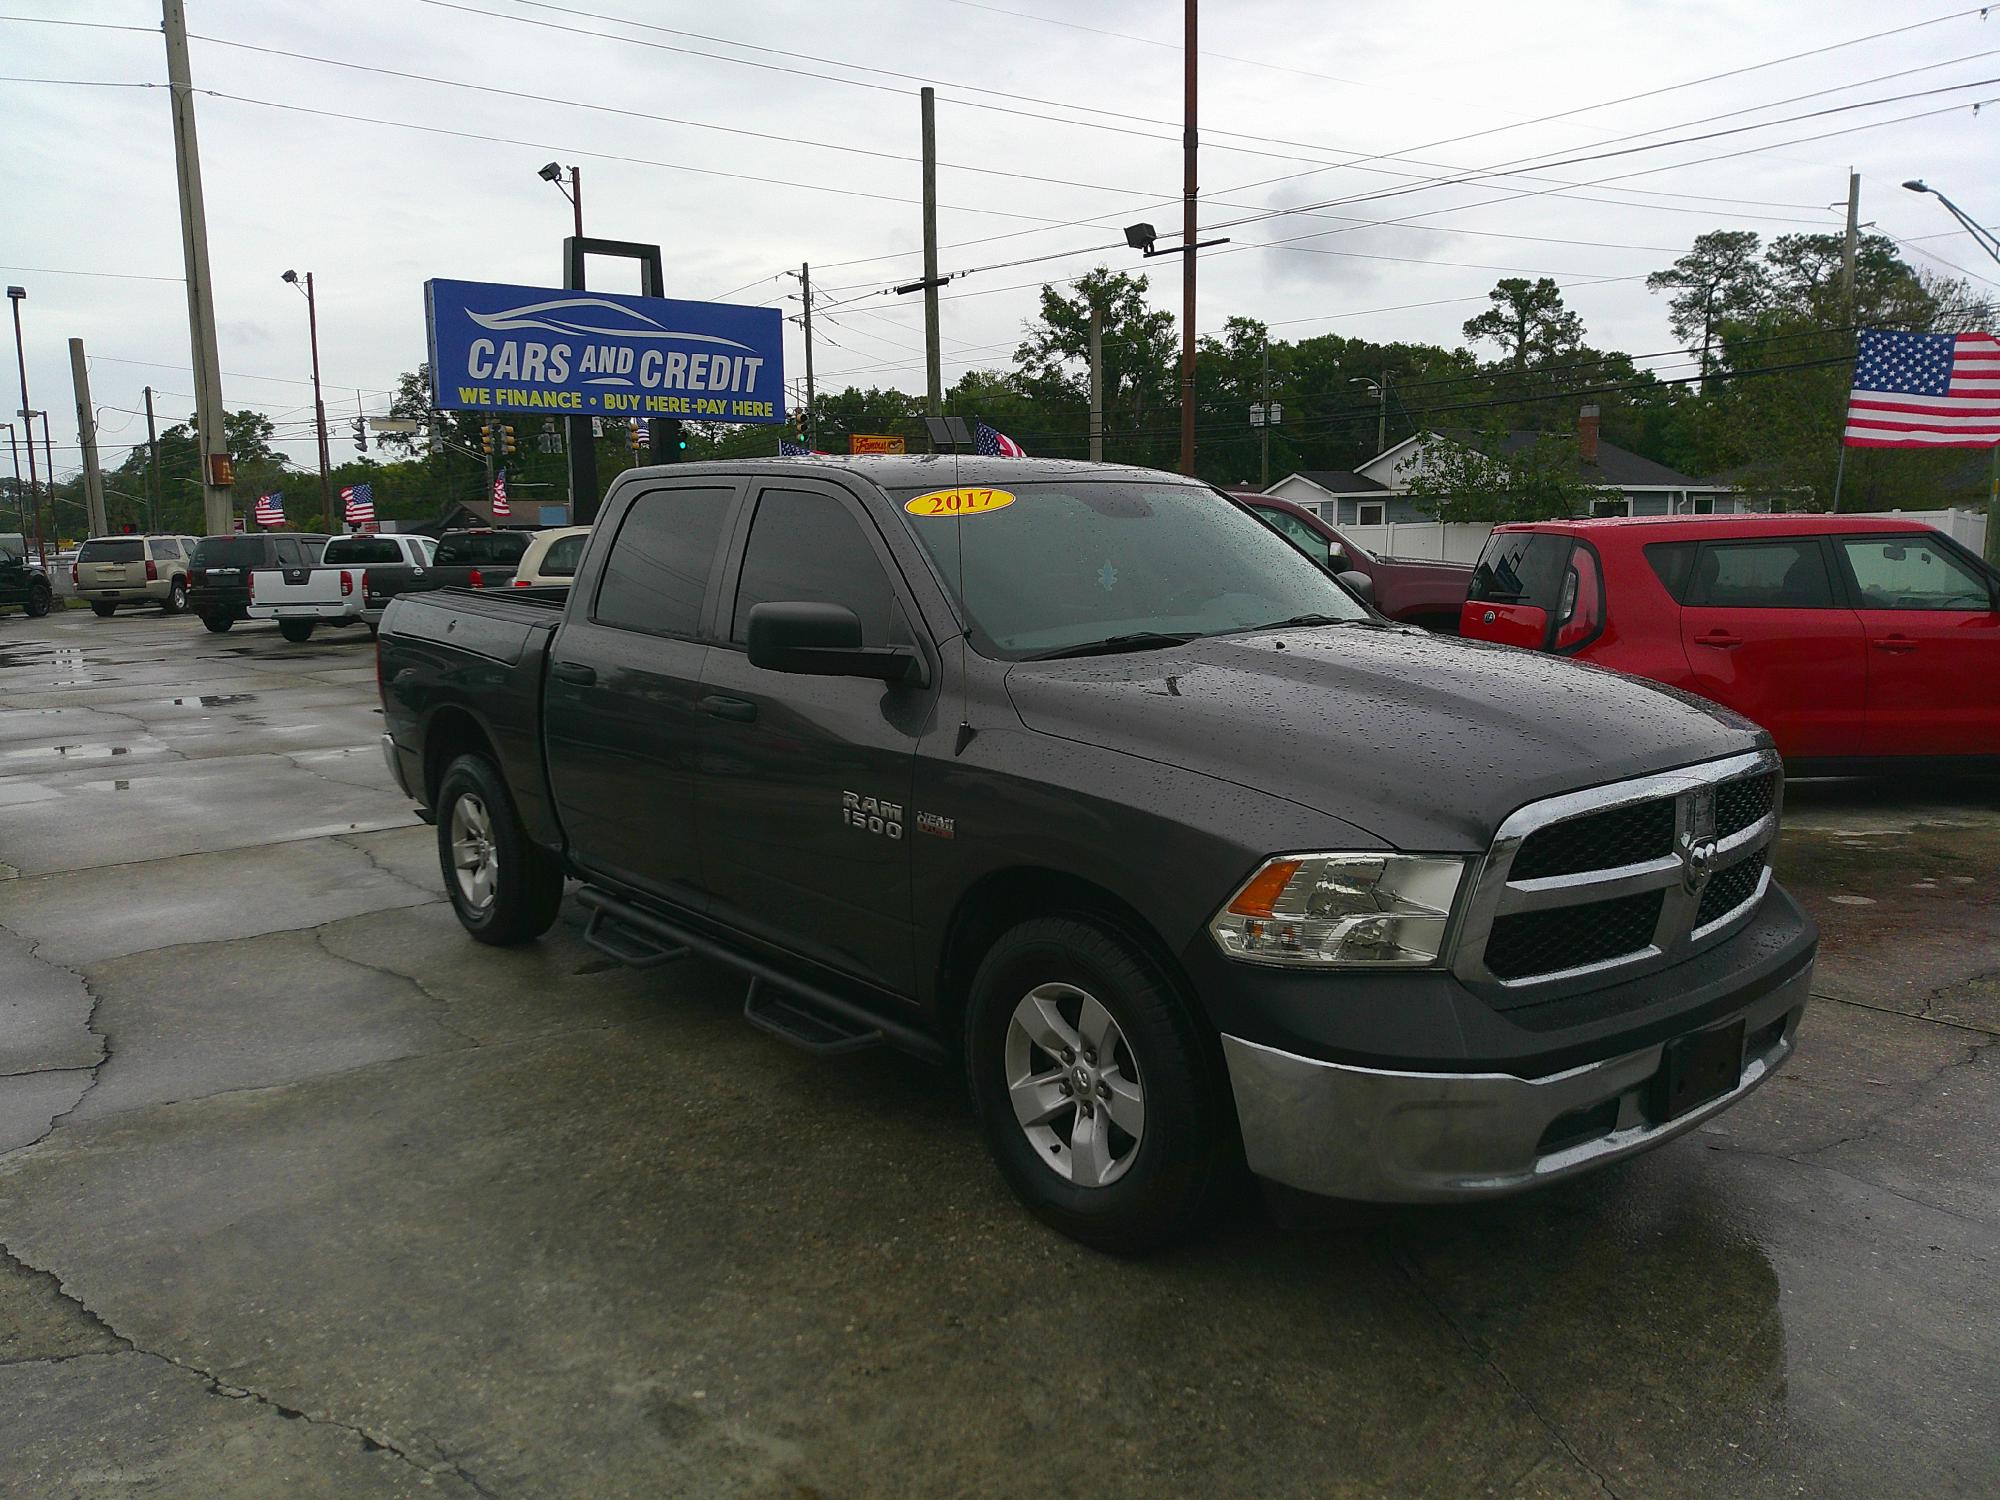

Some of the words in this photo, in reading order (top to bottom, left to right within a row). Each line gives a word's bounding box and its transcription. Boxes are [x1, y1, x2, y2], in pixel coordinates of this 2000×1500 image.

[467, 338, 573, 384] CARS
[579, 345, 635, 375] AND
[639, 350, 764, 393] CREDIT
[458, 387, 491, 405] WE
[496, 388, 582, 409] FINANCE
[604, 393, 642, 412] BUY
[732, 400, 774, 417] HERE
[928, 490, 993, 514] 2017
[842, 790, 903, 821] RAM
[842, 808, 903, 840] 1500
